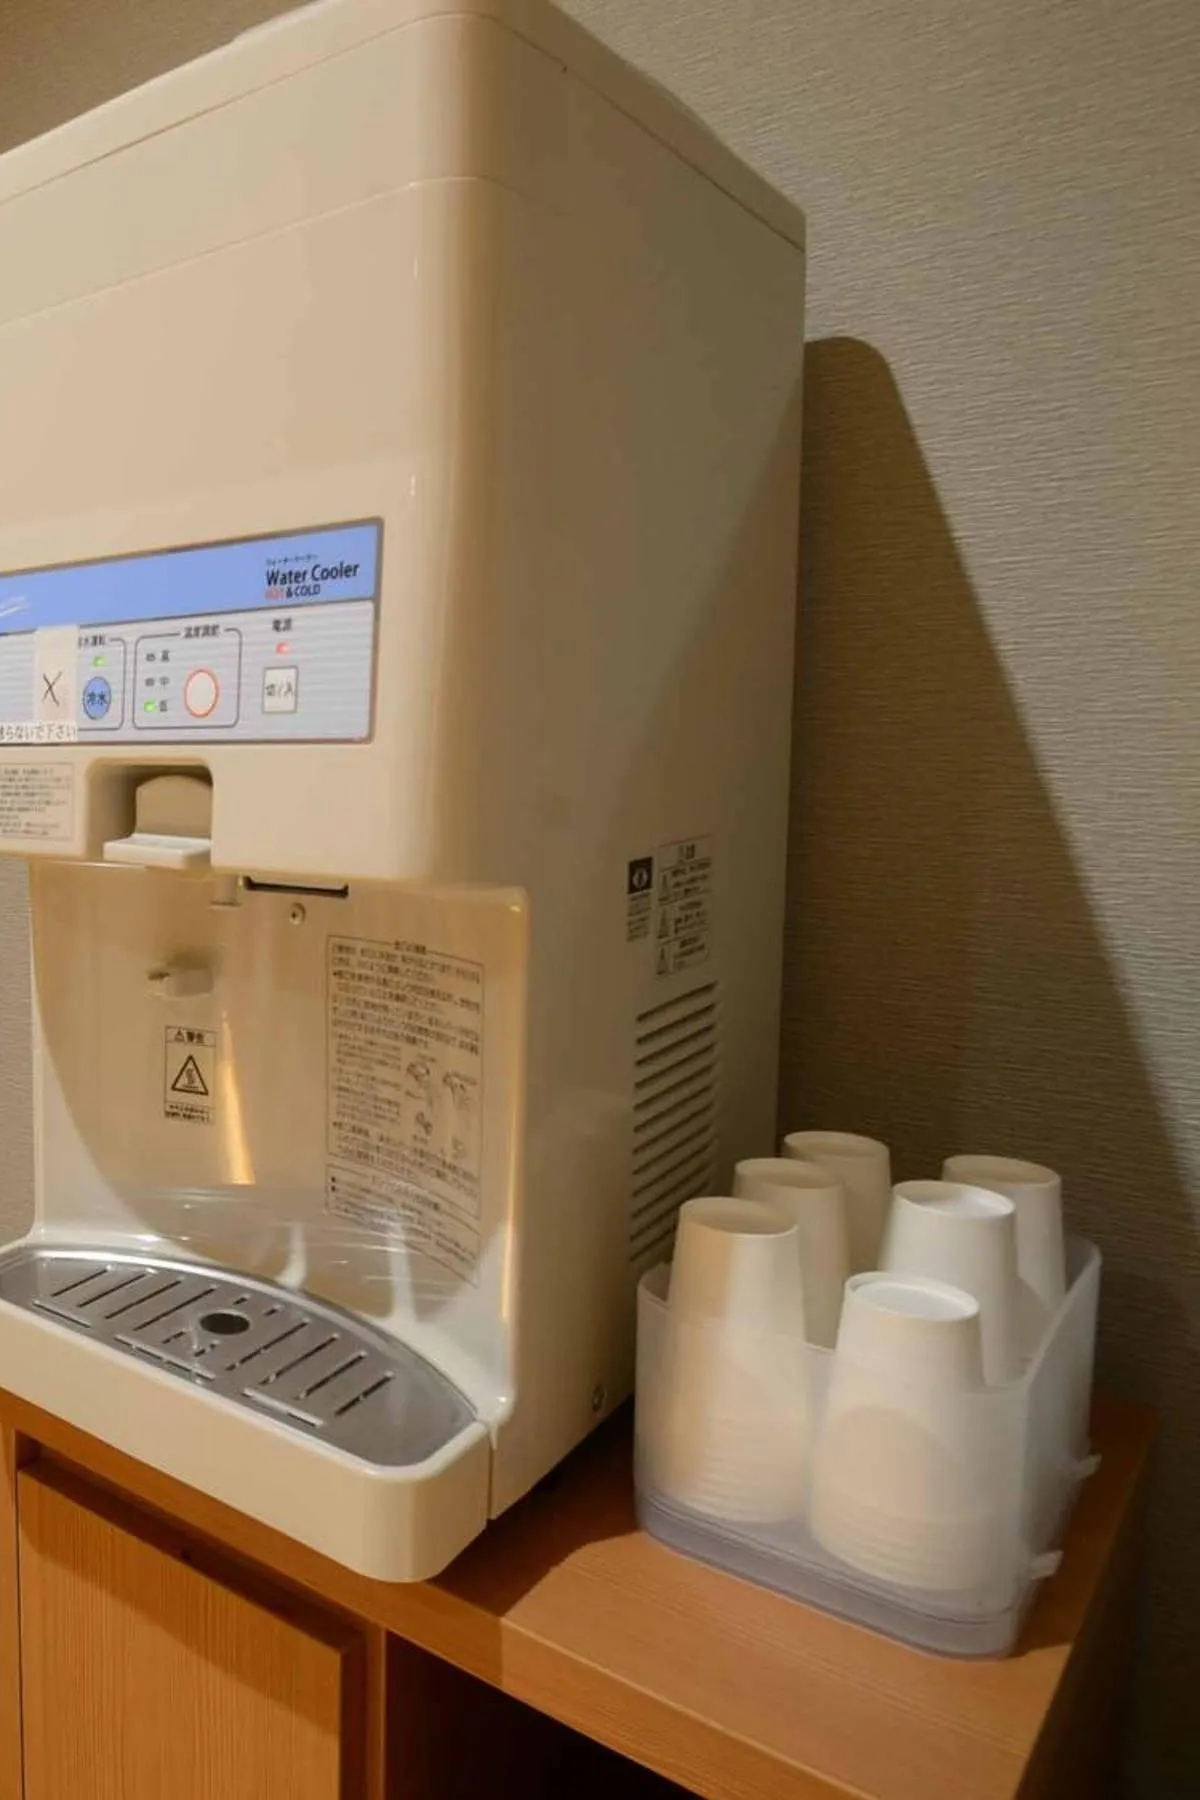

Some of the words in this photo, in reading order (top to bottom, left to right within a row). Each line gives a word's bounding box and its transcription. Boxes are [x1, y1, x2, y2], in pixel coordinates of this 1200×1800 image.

[266, 568, 308, 586] Water
[311, 560, 360, 582] Cooler
[86, 691, 108, 706] 冷水
